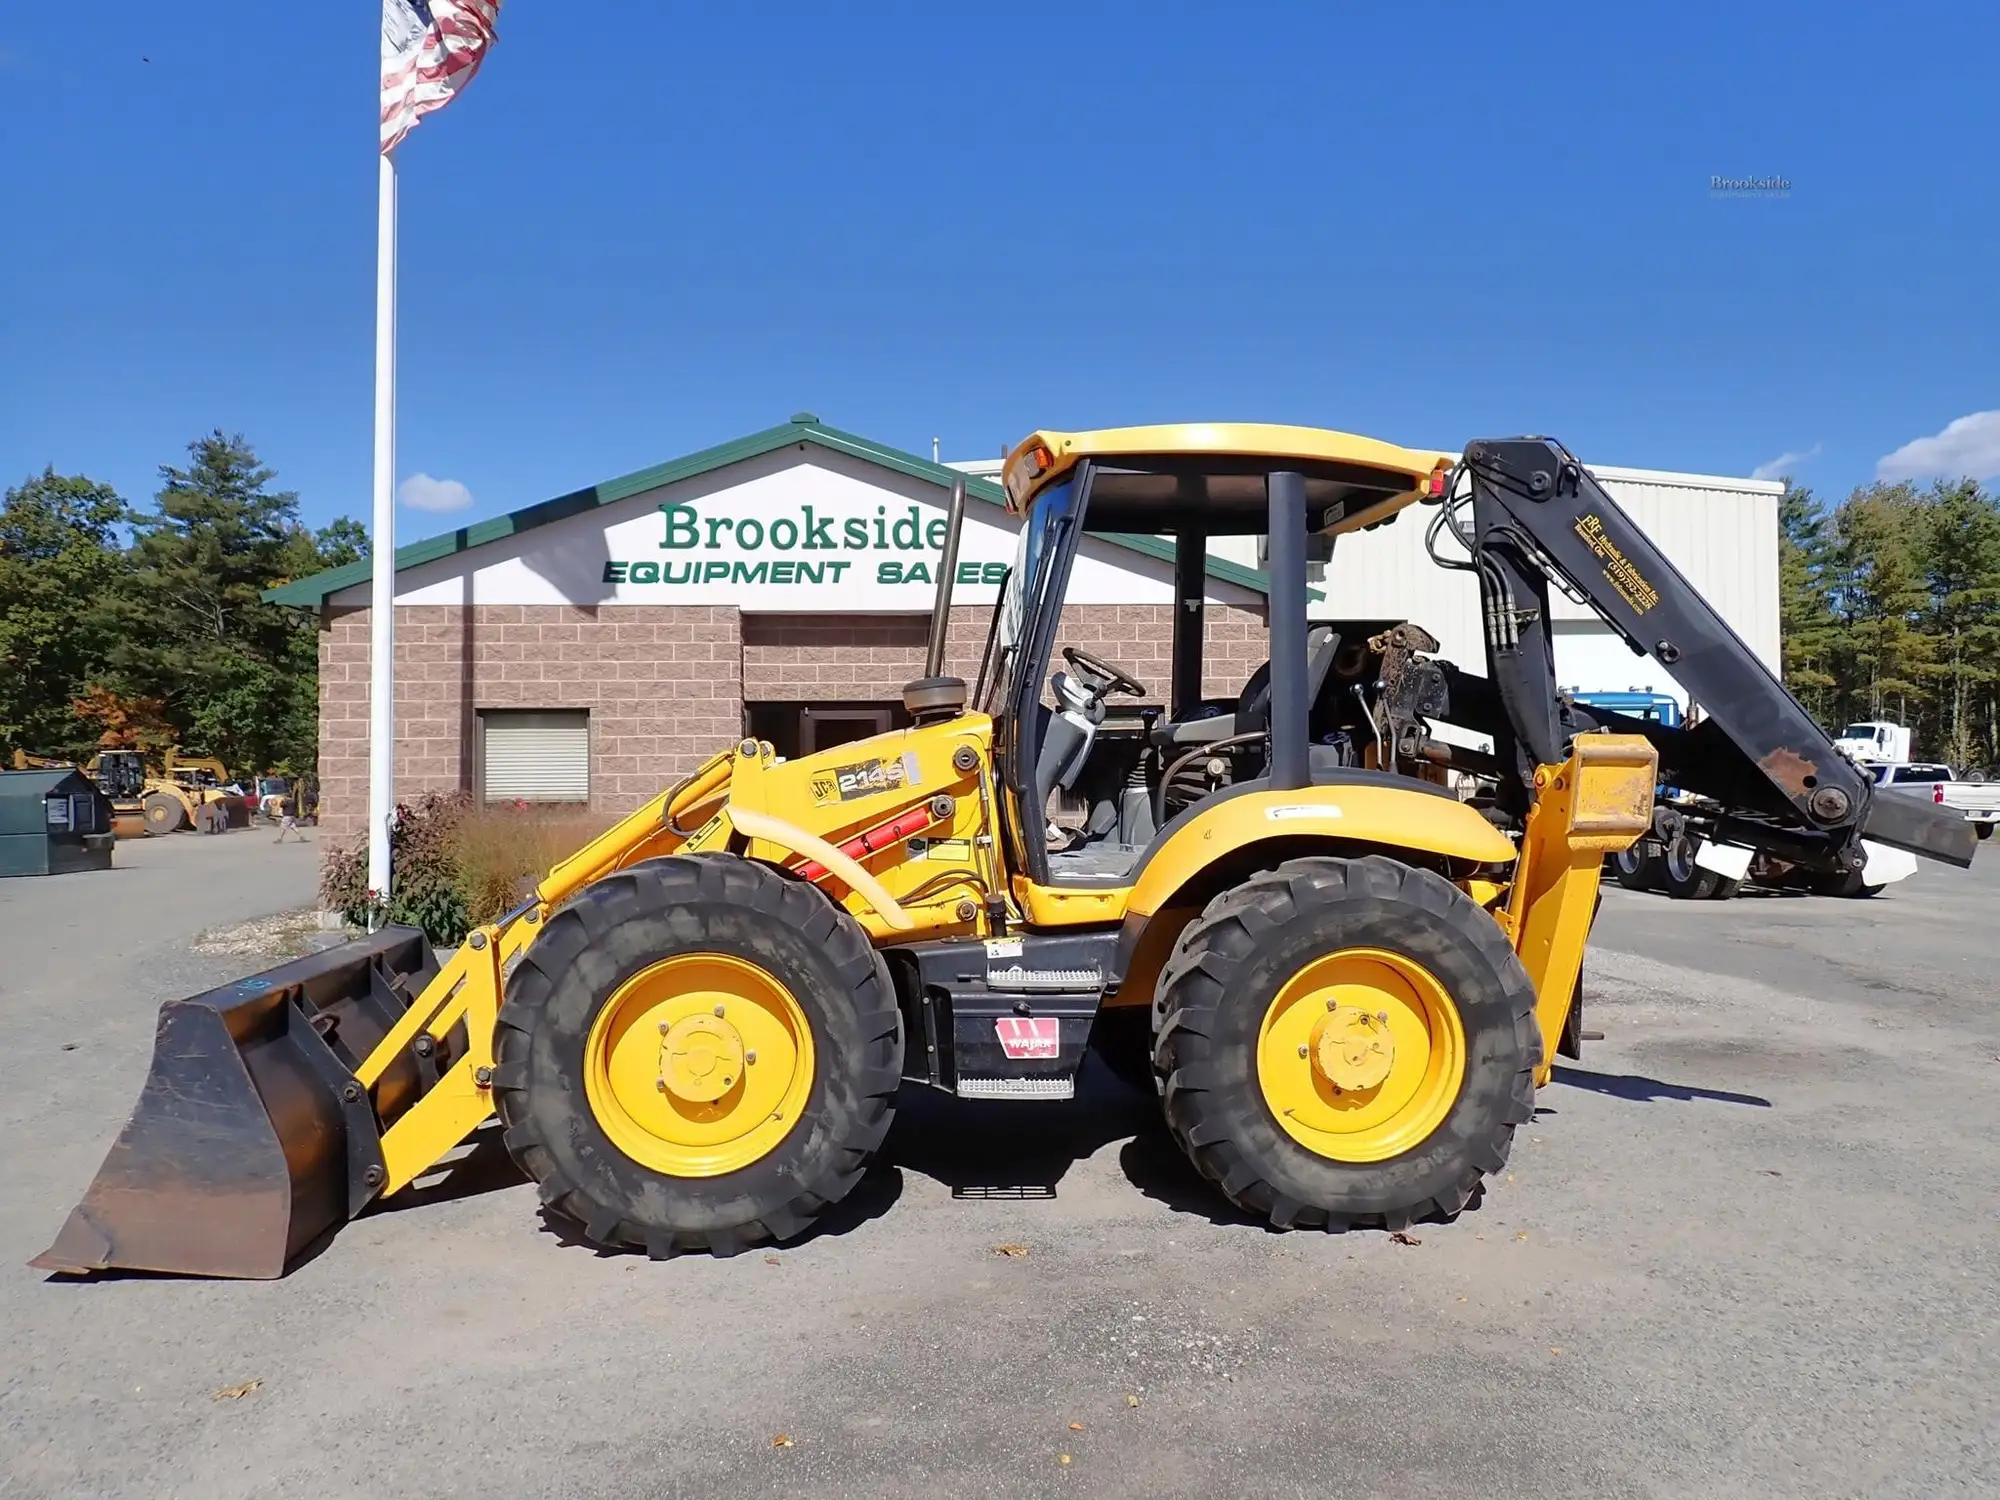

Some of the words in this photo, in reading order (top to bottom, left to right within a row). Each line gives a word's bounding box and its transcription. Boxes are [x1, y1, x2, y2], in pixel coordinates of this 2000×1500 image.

[603, 561, 851, 584] EQUIPMENT
[876, 561, 1007, 584] SAES
[1582, 514, 1602, 533] FRF
[1619, 558, 1628, 566] &
[1624, 563, 1650, 594] Fabrication
